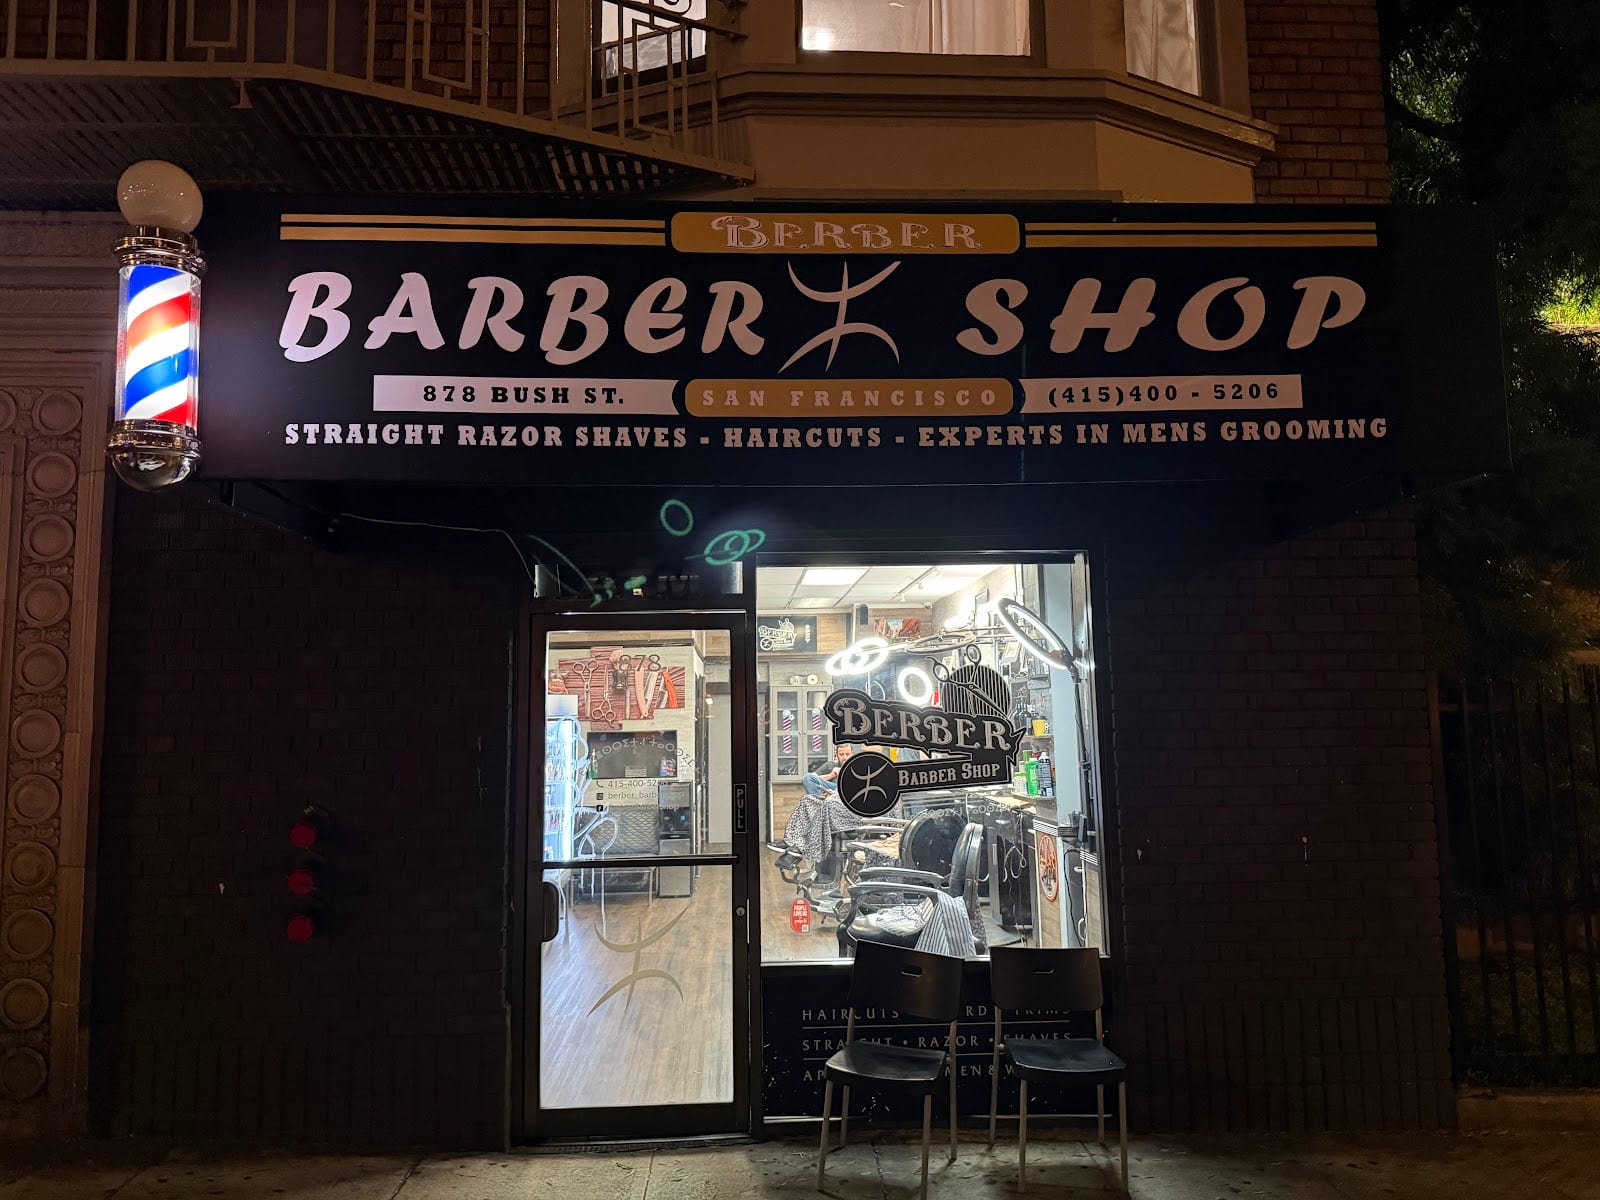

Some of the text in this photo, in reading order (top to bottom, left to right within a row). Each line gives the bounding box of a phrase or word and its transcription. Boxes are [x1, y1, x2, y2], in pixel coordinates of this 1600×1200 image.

[711, 215, 983, 250] BERBER
[279, 272, 1366, 365] BARBER SHOP
[424, 386, 624, 404] 878 BUSH ST.
[702, 389, 996, 407] SAN FRANCISCO
[1048, 384, 1177, 408] (415)400
[1213, 382, 1278, 400] 5206
[285, 423, 444, 445] STRAIGHT
[458, 425, 562, 447] RAZOR
[576, 426, 687, 448] SHAVES
[723, 427, 881, 448] HAIRCUTS
[919, 424, 1064, 447] EXPERTS
[1076, 423, 1109, 444] IN
[1122, 421, 1207, 444] MENS
[1220, 417, 1387, 442] GROOMING
[618, 654, 662, 672] 878
[832, 697, 1011, 751] BERBER
[608, 779, 658, 788] 415-400-52
[899, 762, 1001, 787] BARBER SHOP
[736, 788, 744, 829] PULL
[802, 1037, 893, 1051] STRAHT
[918, 1035, 979, 1048] RAZOR
